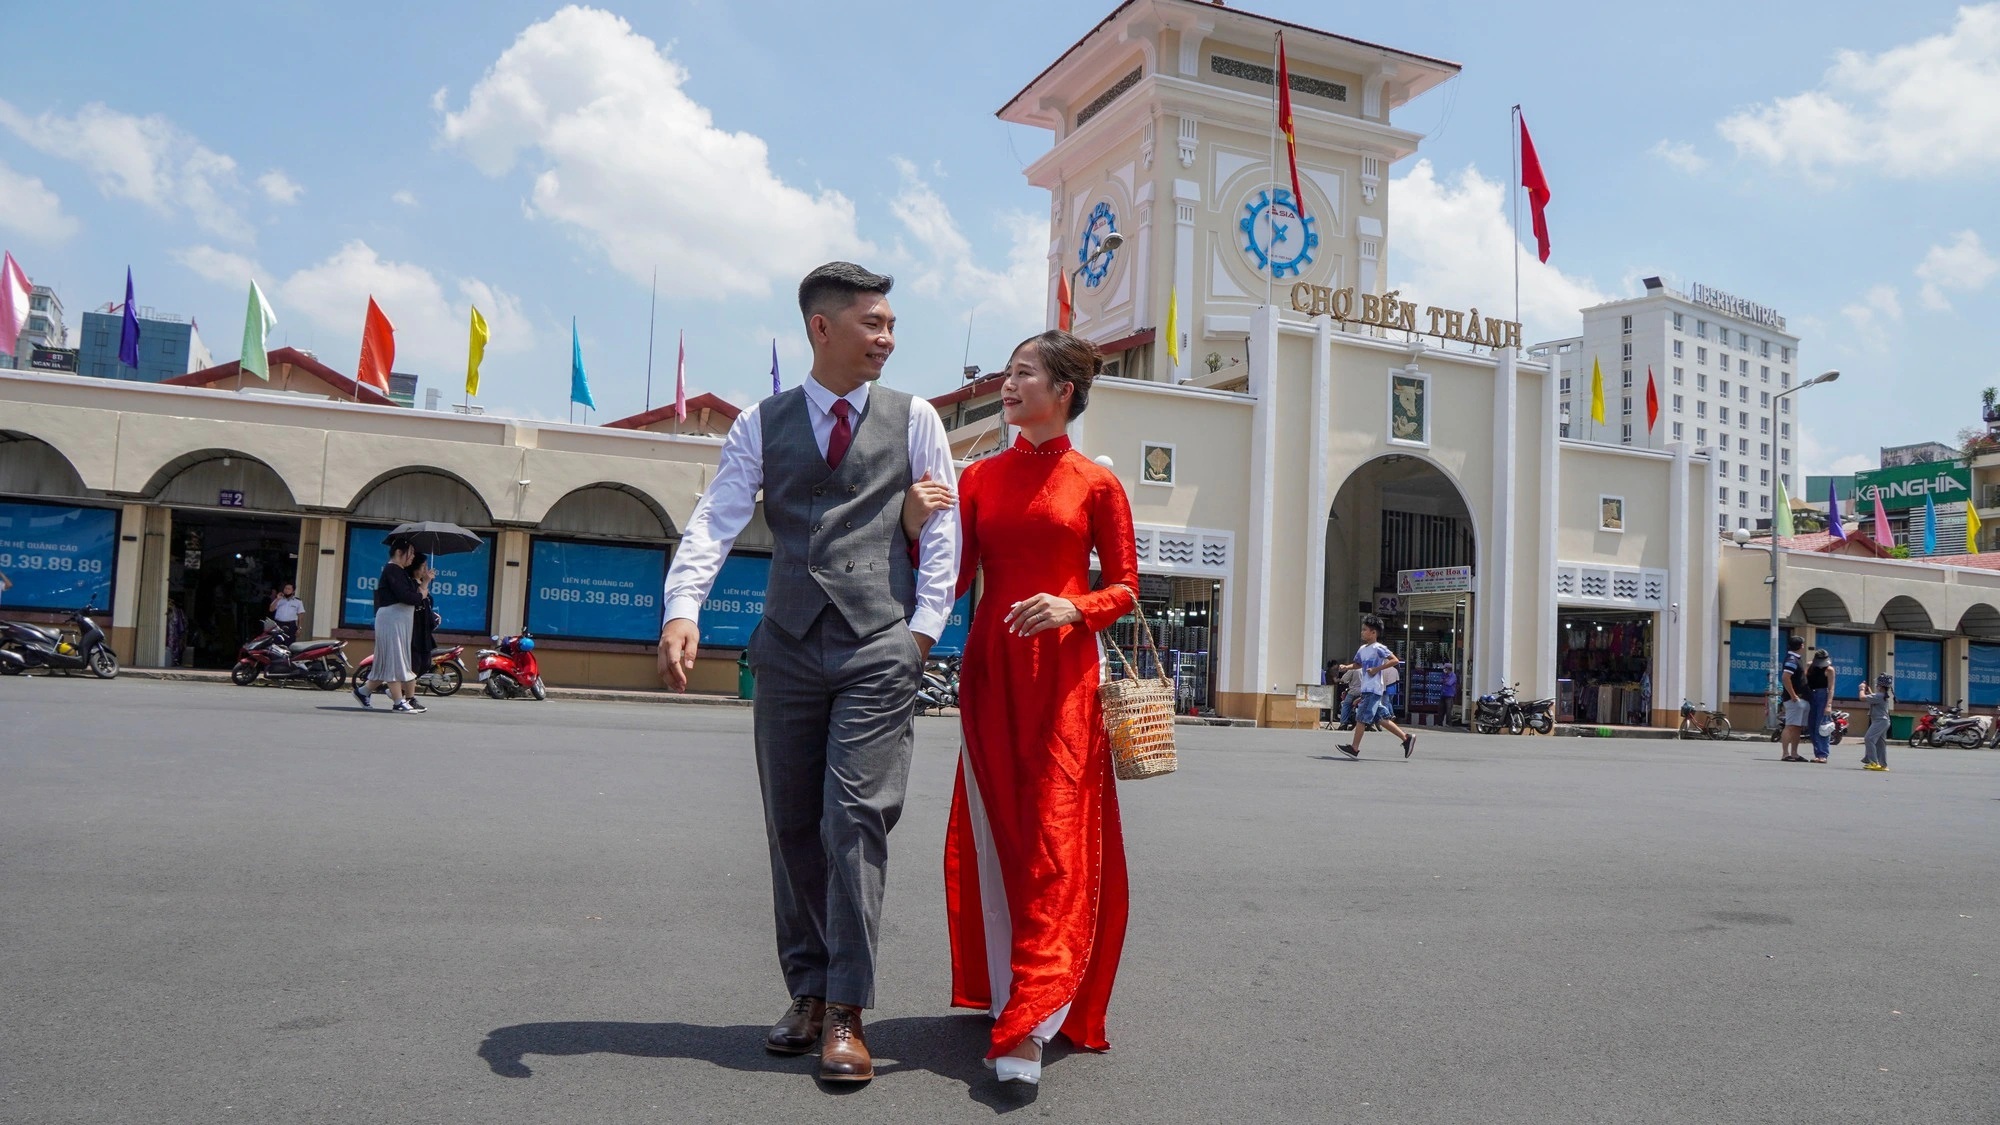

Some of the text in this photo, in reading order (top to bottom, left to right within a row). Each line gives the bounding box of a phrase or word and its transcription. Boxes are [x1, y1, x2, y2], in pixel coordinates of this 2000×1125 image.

[1290, 280, 1523, 350] CHỢ BẾN THÀNH
[233, 493, 242, 506] 2
[60, 544, 79, 553] CÁO
[0, 553, 102, 574] 9.39.89.89
[581, 578, 591, 586] HỆ
[540, 587, 654, 608] 0969.39.89.89
[703, 599, 765, 615] 0969.39
[1835, 665, 1863, 676] 9.89.89
[1895, 669, 1938, 681] 69.39.89.89
